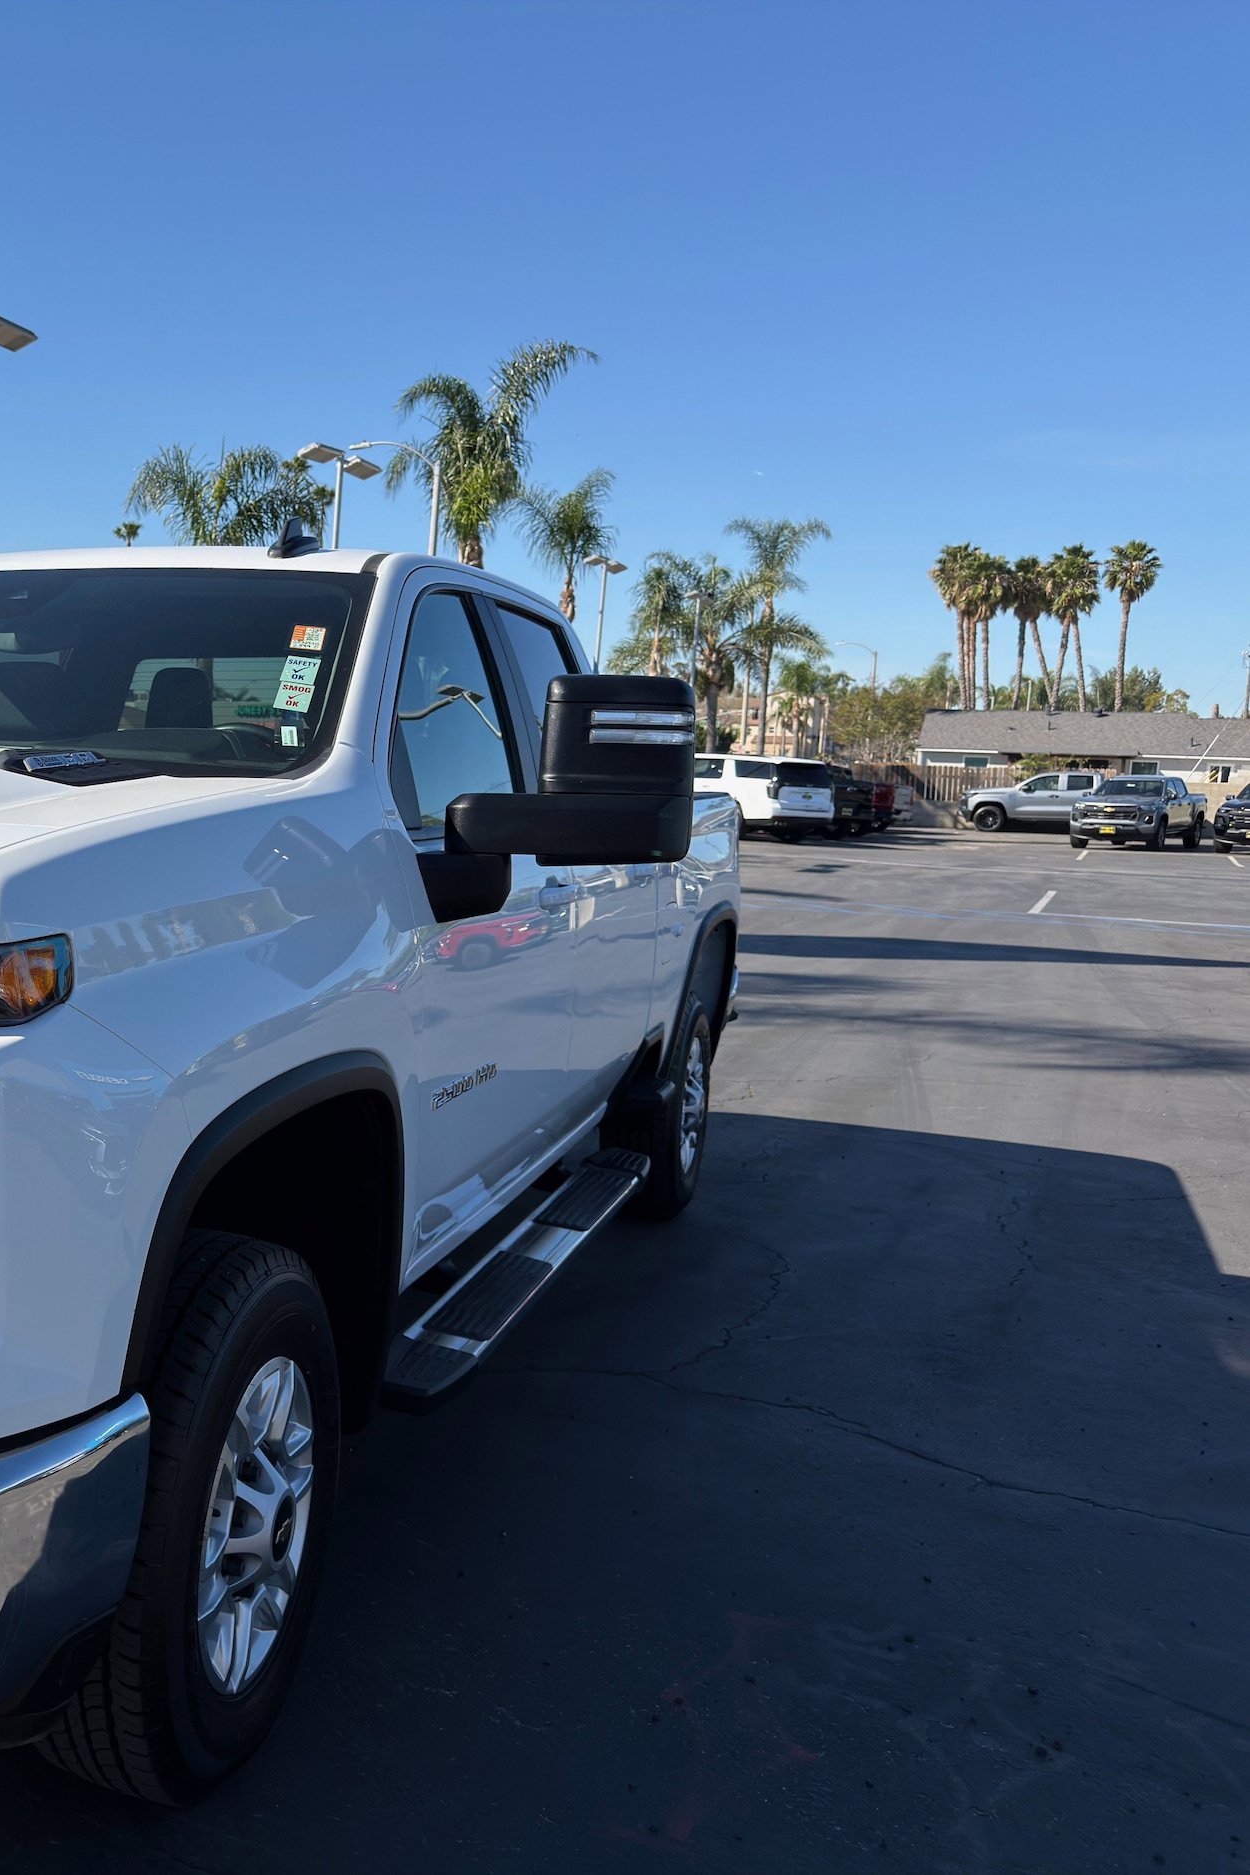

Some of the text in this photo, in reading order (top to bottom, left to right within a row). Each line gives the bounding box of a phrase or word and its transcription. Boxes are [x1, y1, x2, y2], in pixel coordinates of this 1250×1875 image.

[287, 658, 318, 667] SAFETY
[291, 673, 305, 681] OK
[282, 684, 311, 694] SMOG
[285, 700, 299, 708] OK
